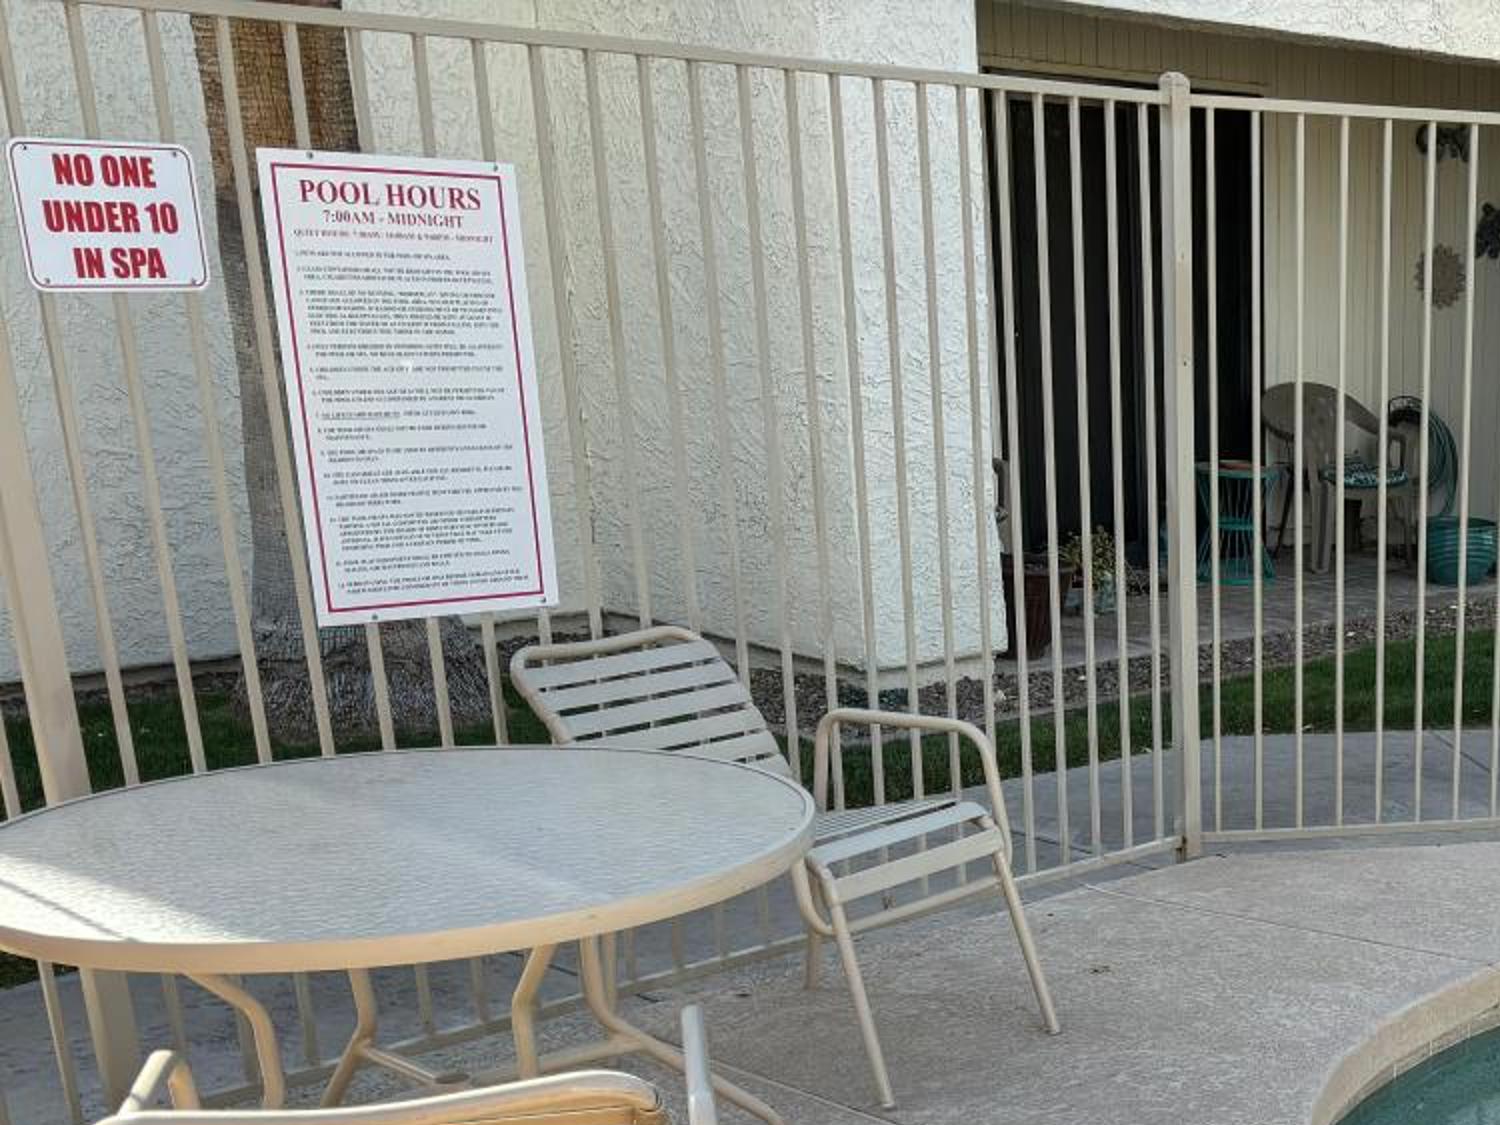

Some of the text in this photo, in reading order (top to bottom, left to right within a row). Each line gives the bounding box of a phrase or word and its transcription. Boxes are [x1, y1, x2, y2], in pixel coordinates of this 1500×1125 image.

[52, 153, 157, 188] NO ONE
[299, 179, 481, 211] POOL HOURS
[42, 199, 179, 234] UNDER 10
[323, 208, 375, 225] 7:00AM
[387, 212, 464, 229] MIDNIGHT
[73, 247, 168, 278] IN SPA
